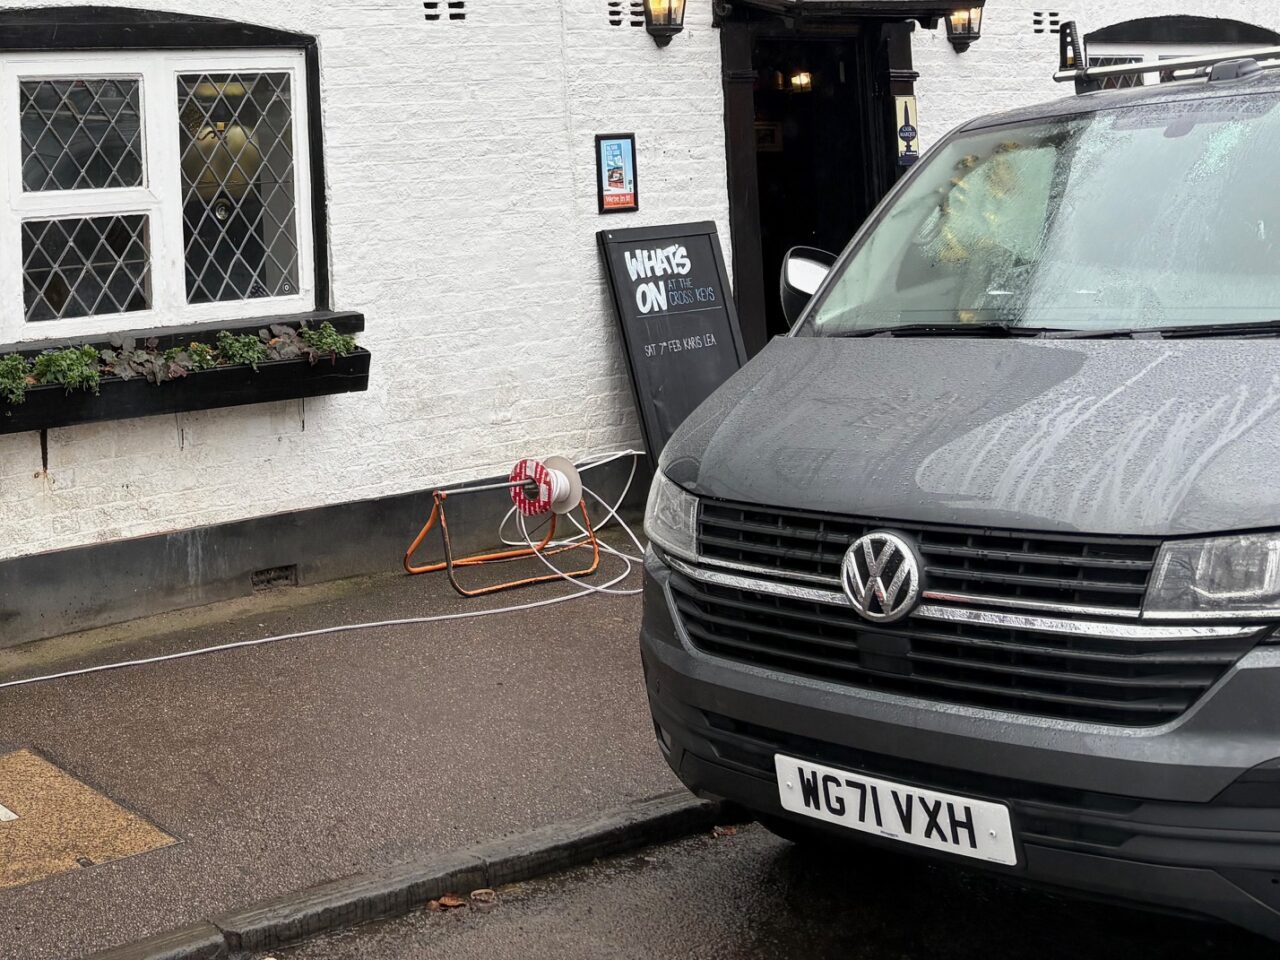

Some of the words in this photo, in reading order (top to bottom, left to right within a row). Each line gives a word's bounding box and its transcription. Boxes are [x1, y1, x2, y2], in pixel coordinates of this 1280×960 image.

[624, 244, 691, 282] WHAT'S
[636, 281, 668, 314] ON
[668, 279, 677, 290] AT
[678, 277, 694, 289] THE
[669, 290, 694, 306] CROSS
[695, 287, 715, 302] KEYS
[644, 343, 657, 357] SAT
[668, 339, 682, 353] FEB
[683, 335, 703, 350] KARIS
[703, 333, 717, 348] LEA
[797, 766, 883, 828] WG71
[890, 790, 978, 849] VXH
